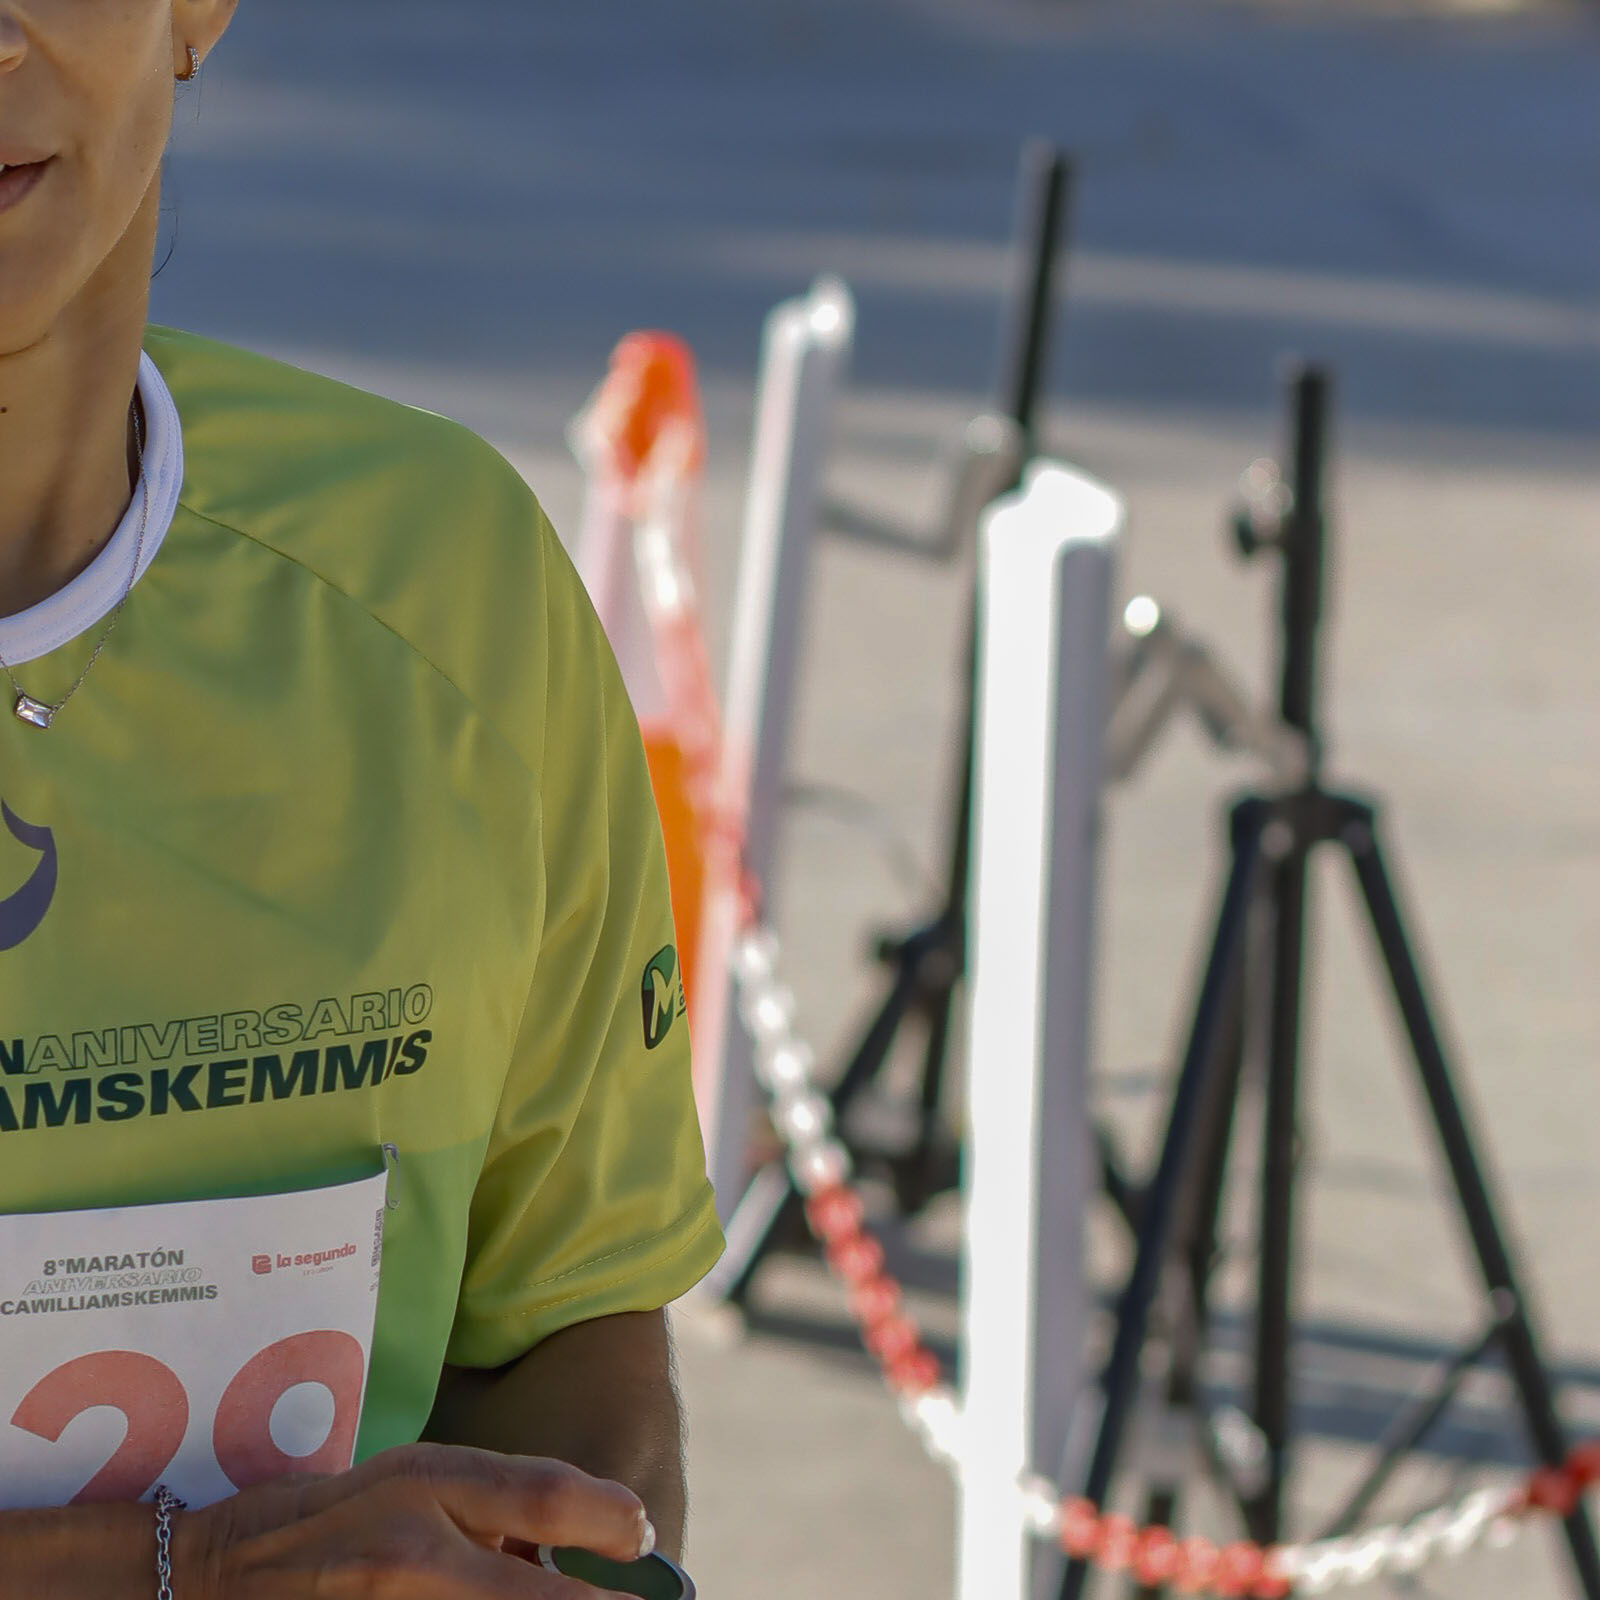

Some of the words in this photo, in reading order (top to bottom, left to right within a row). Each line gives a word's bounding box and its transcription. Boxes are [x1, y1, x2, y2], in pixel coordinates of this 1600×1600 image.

[276, 1253, 292, 1268] la
[294, 1243, 357, 1266] segunda
[22, 1267, 204, 1296] ANIVERSARIO
[0, 1284, 219, 1315] CAWILLIAMSKEMMIS
